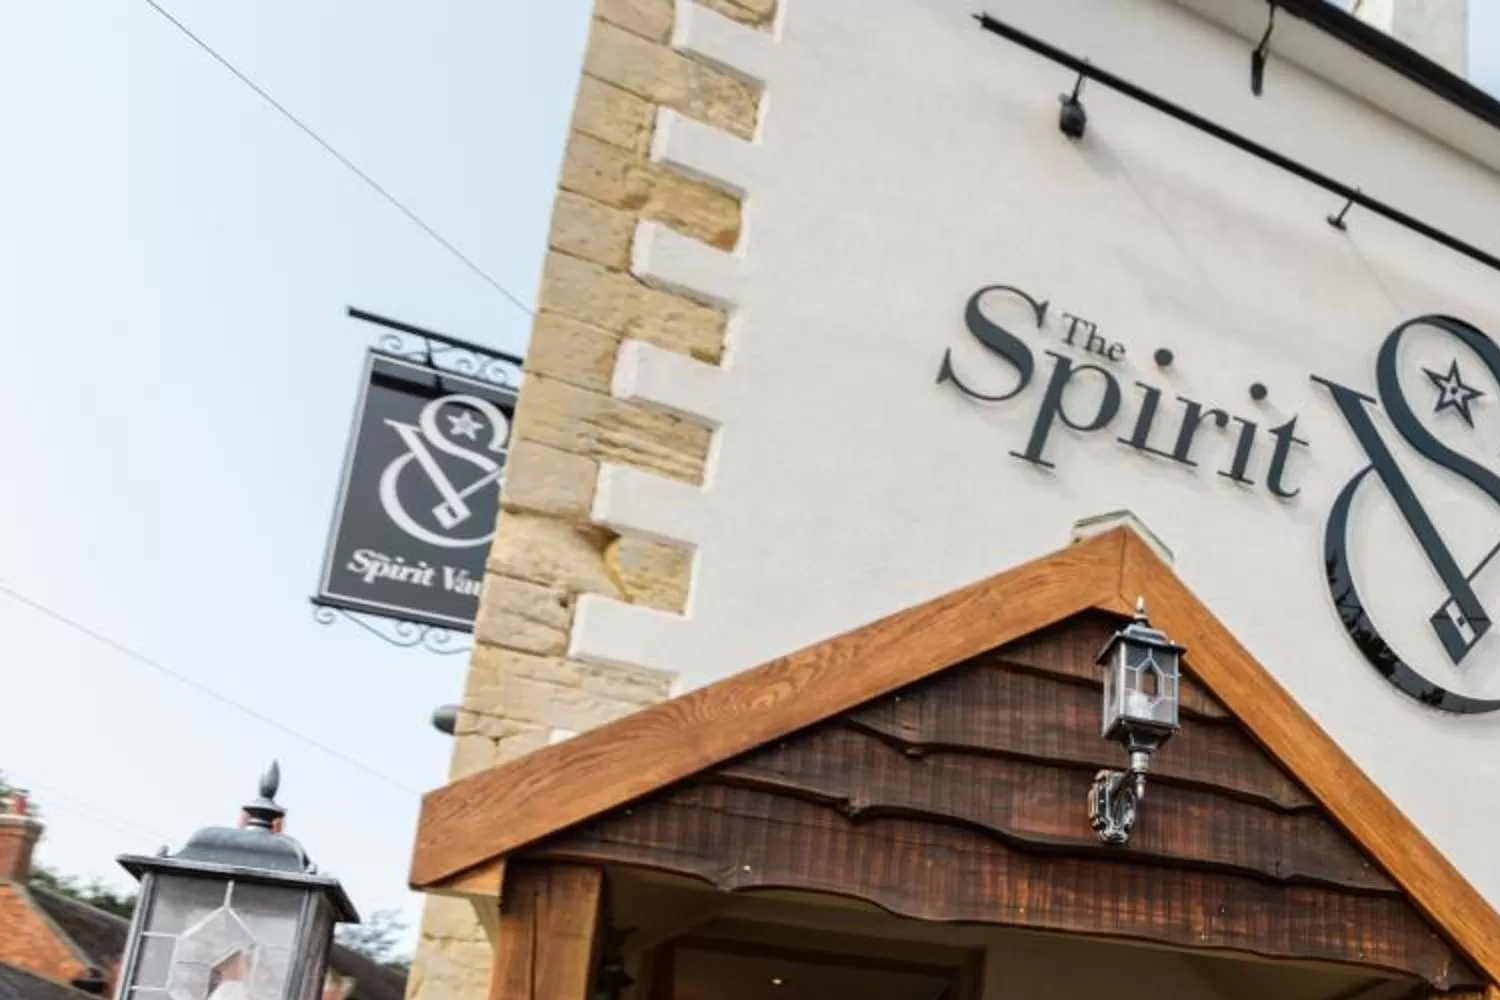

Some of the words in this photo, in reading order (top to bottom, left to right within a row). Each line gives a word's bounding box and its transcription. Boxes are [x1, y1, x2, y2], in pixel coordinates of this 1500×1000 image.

[1061, 311, 1127, 362] The
[936, 284, 1309, 498] Spirit
[346, 549, 435, 587] Spirit
[442, 565, 482, 597] Vau
